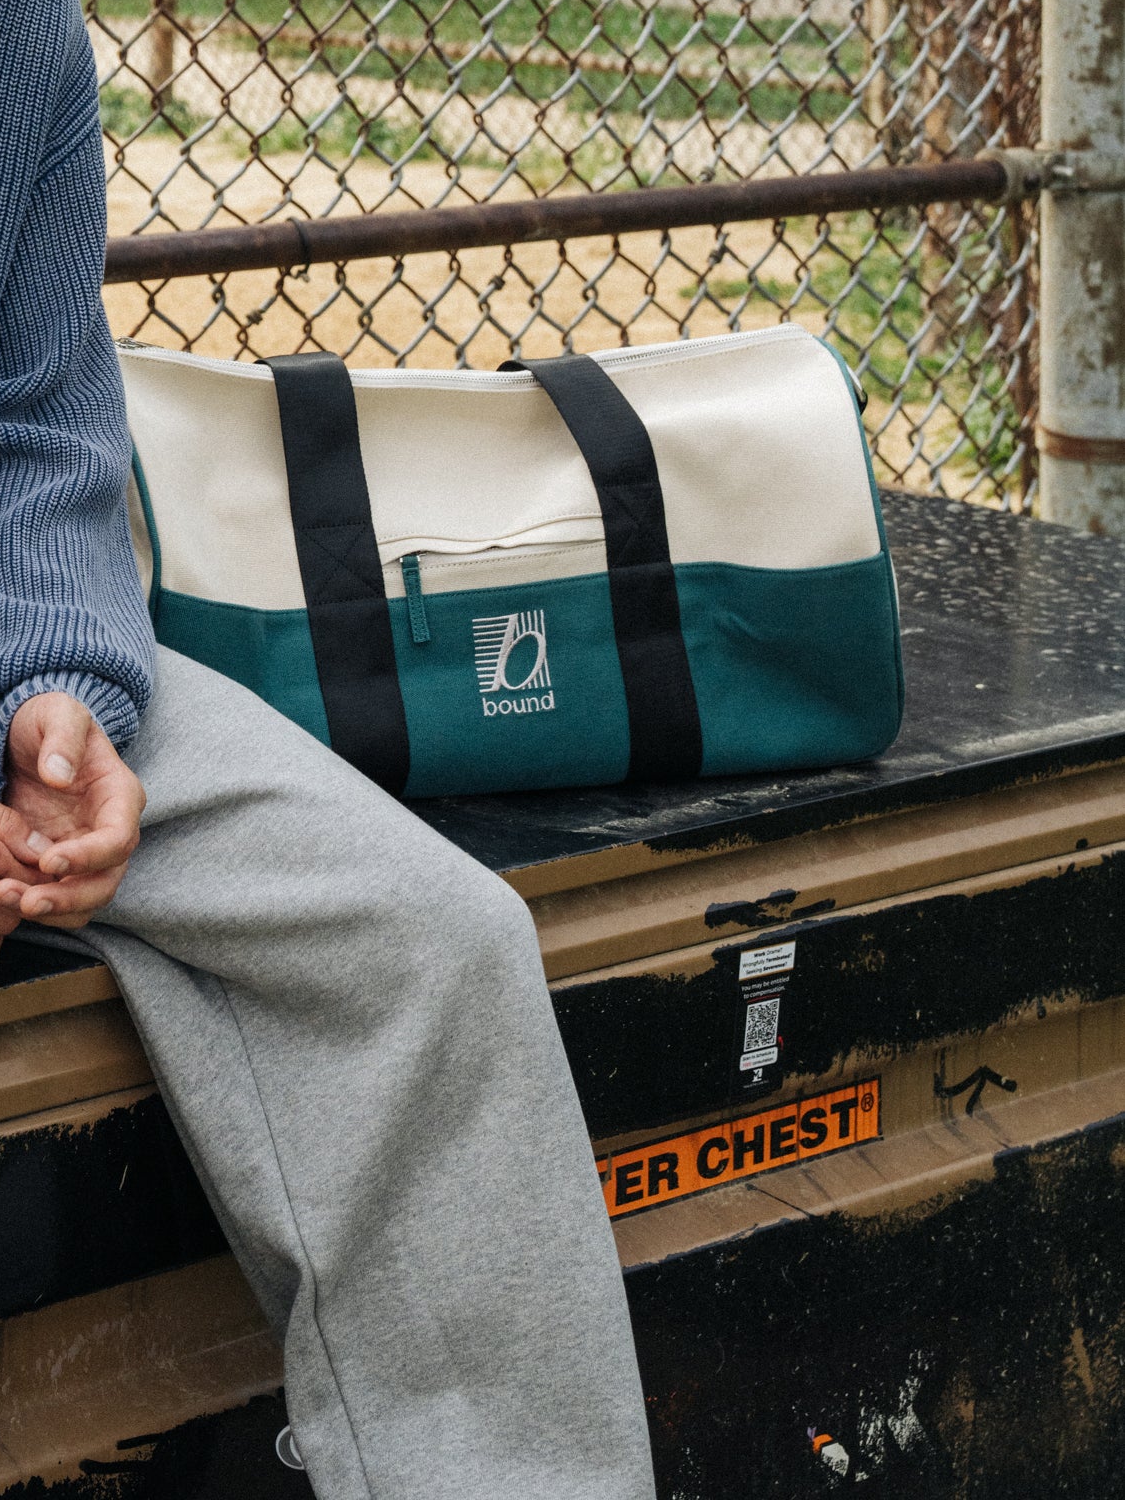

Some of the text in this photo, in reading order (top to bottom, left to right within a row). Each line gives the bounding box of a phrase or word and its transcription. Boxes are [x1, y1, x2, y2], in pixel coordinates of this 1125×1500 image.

[482, 690, 555, 716] bound
[770, 976, 790, 985] entitled
[597, 1152, 679, 1206] ER
